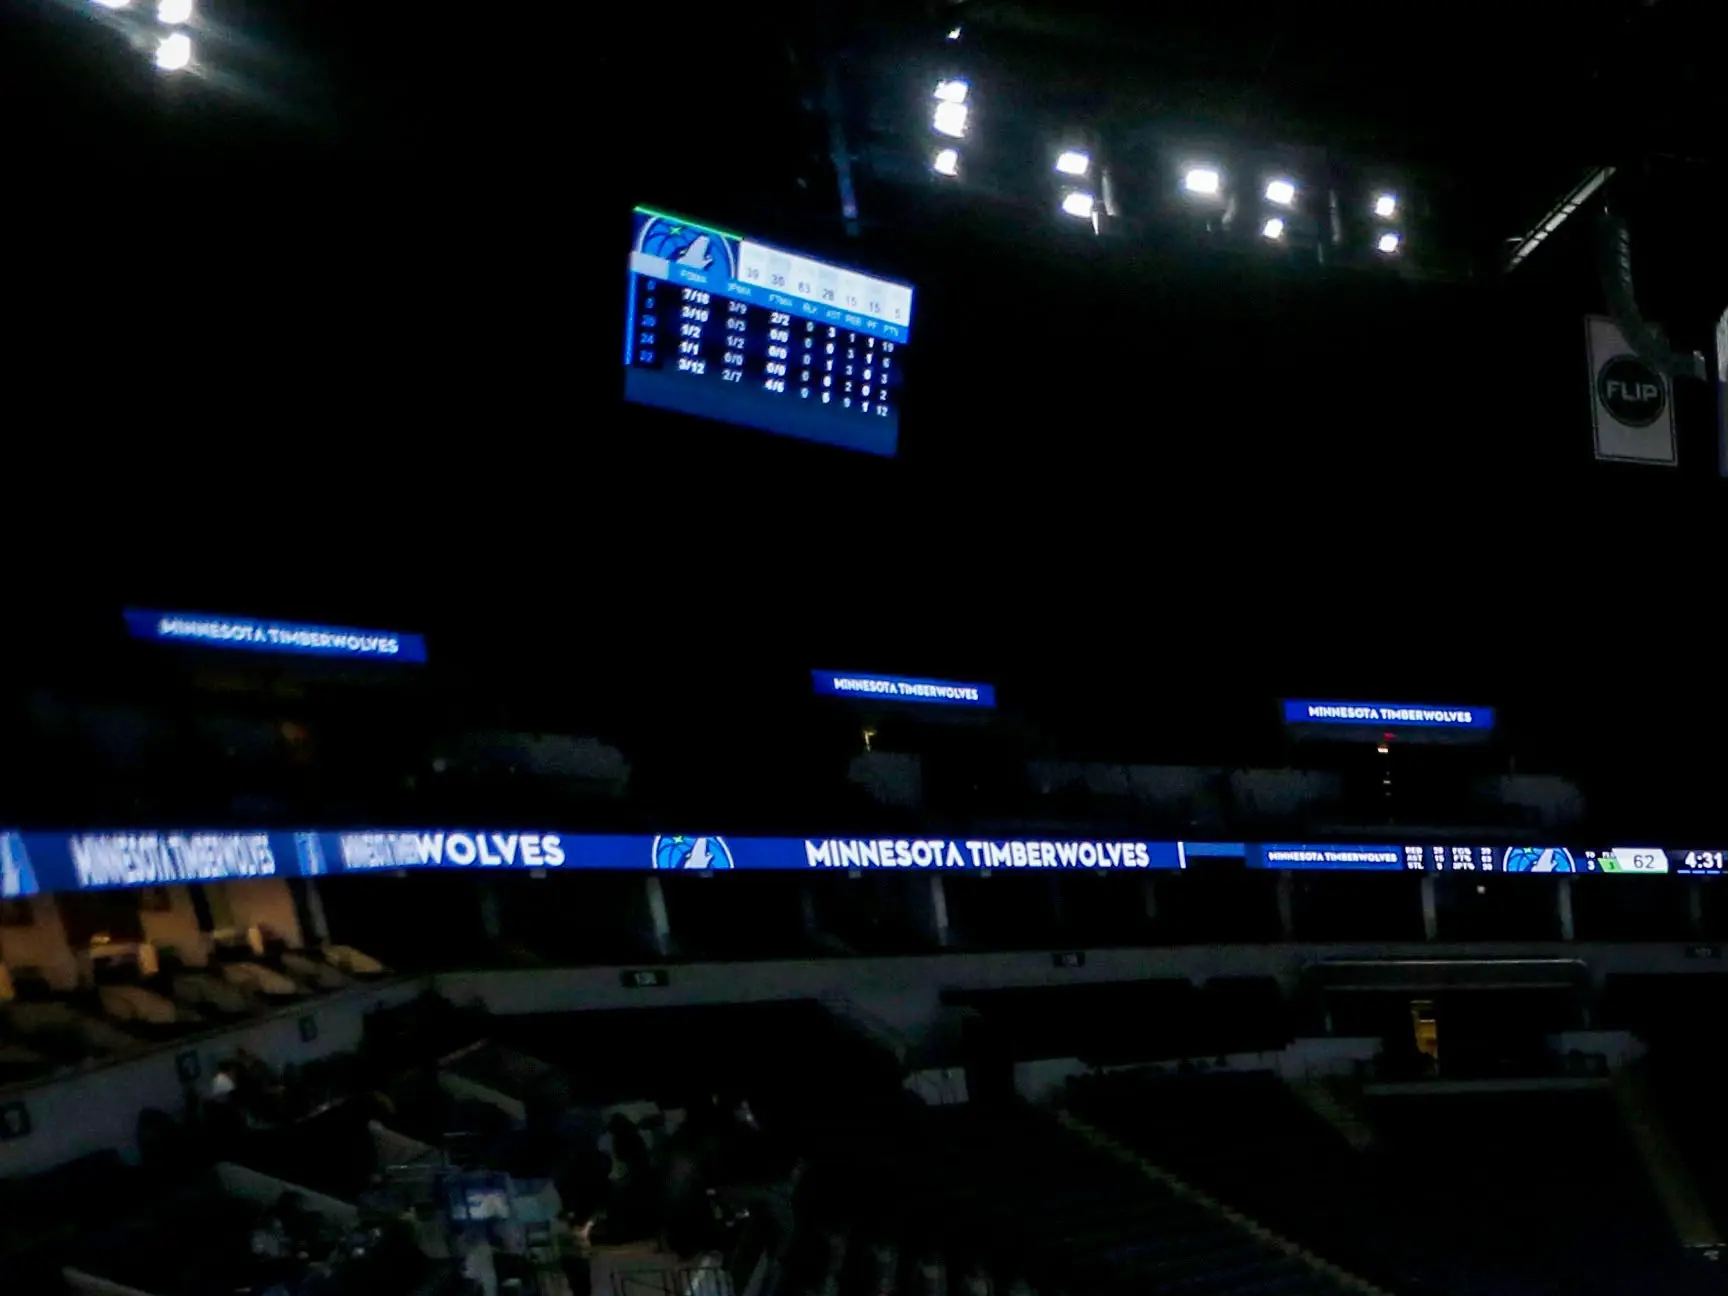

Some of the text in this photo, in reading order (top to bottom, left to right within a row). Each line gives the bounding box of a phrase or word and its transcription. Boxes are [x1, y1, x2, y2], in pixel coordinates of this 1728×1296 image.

[846, 295, 857, 306] 15
[869, 301, 881, 314] 15
[1605, 380, 1660, 403] FLIP
[158, 616, 399, 655] MINNESOTA TIMBERWOLVES
[833, 677, 979, 701] MINNESOTA TIMBERWOLVES
[1308, 705, 1473, 723] MINNESOTA TIMBERWOLVES
[804, 838, 1151, 869] MINNESOTA TIMBERWOLVES
[1267, 850, 1324, 863] MINNESOTA
[1324, 851, 1399, 864] TIMBERWOLVES
[1633, 854, 1655, 869] 62
[1684, 851, 1724, 870] 4:31
